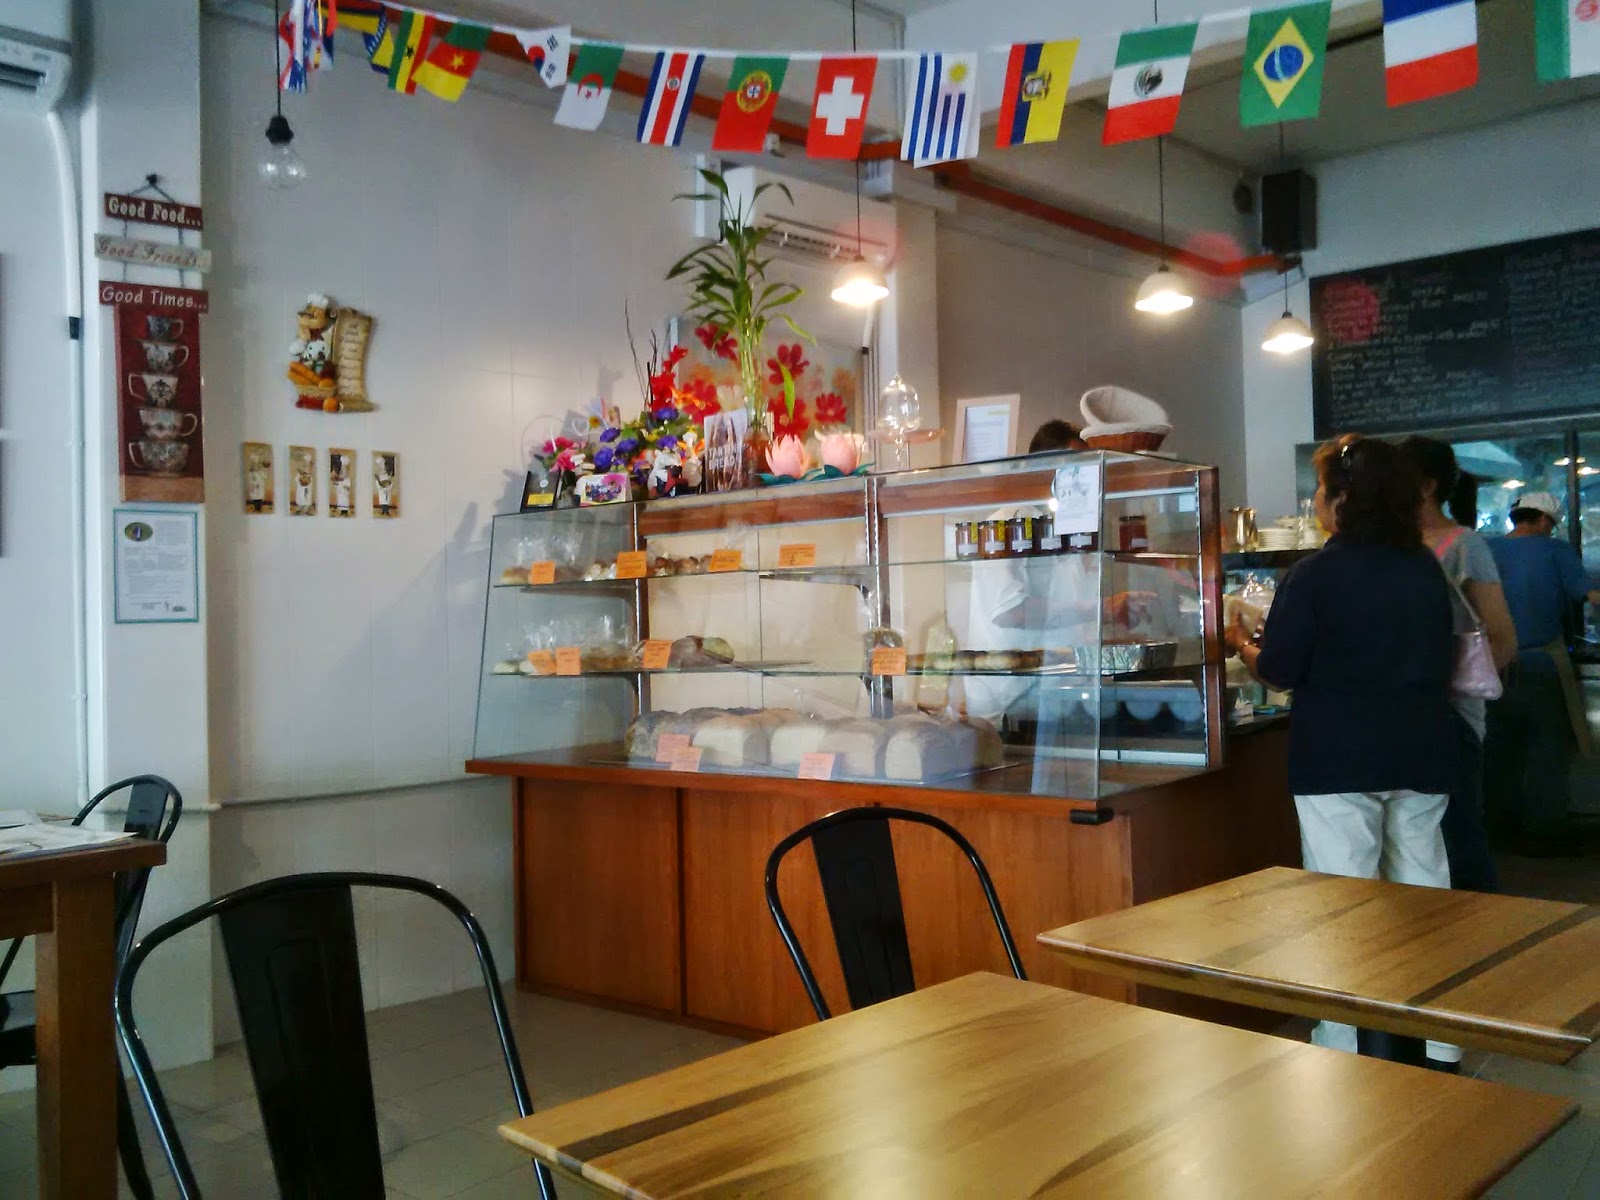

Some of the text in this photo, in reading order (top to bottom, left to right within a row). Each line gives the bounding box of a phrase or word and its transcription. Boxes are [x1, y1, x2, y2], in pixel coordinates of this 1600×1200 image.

[108, 196, 201, 226] Good Food...
[101, 286, 207, 309] Good Times...
